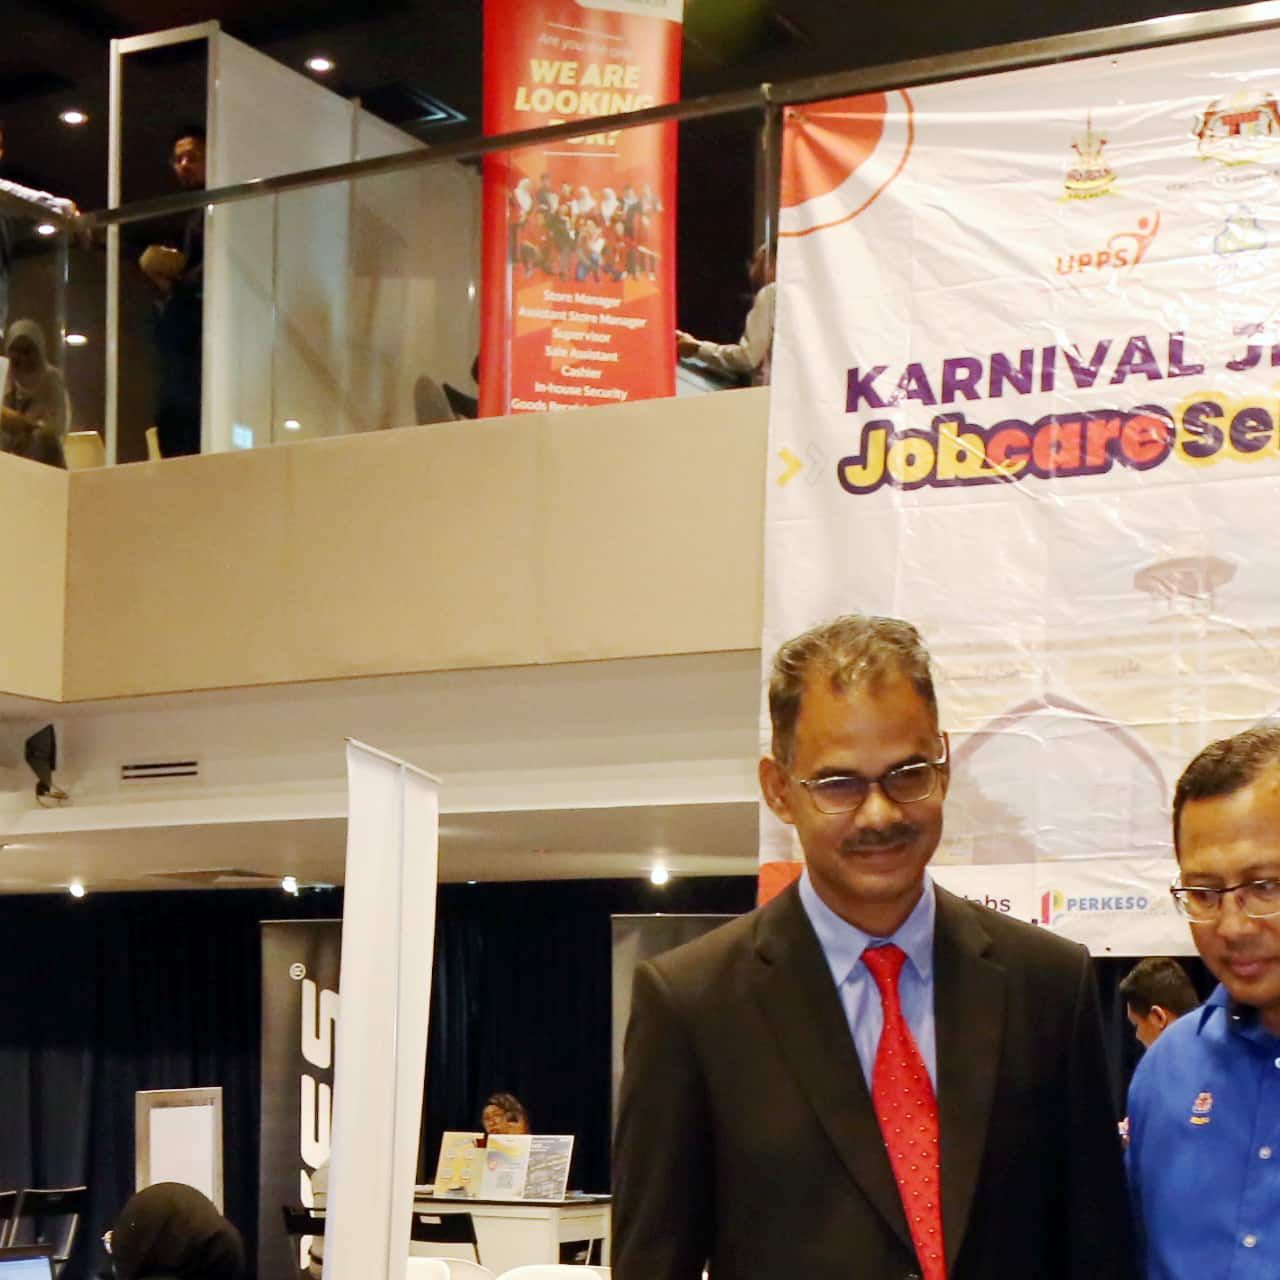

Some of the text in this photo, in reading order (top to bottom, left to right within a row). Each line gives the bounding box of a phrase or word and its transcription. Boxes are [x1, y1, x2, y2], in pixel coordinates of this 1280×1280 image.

[530, 59, 641, 89] WE ARE
[1056, 248, 1129, 276] UPPS
[845, 331, 1205, 413] KARNIVAL
[1067, 896, 1148, 911] PERKESO
